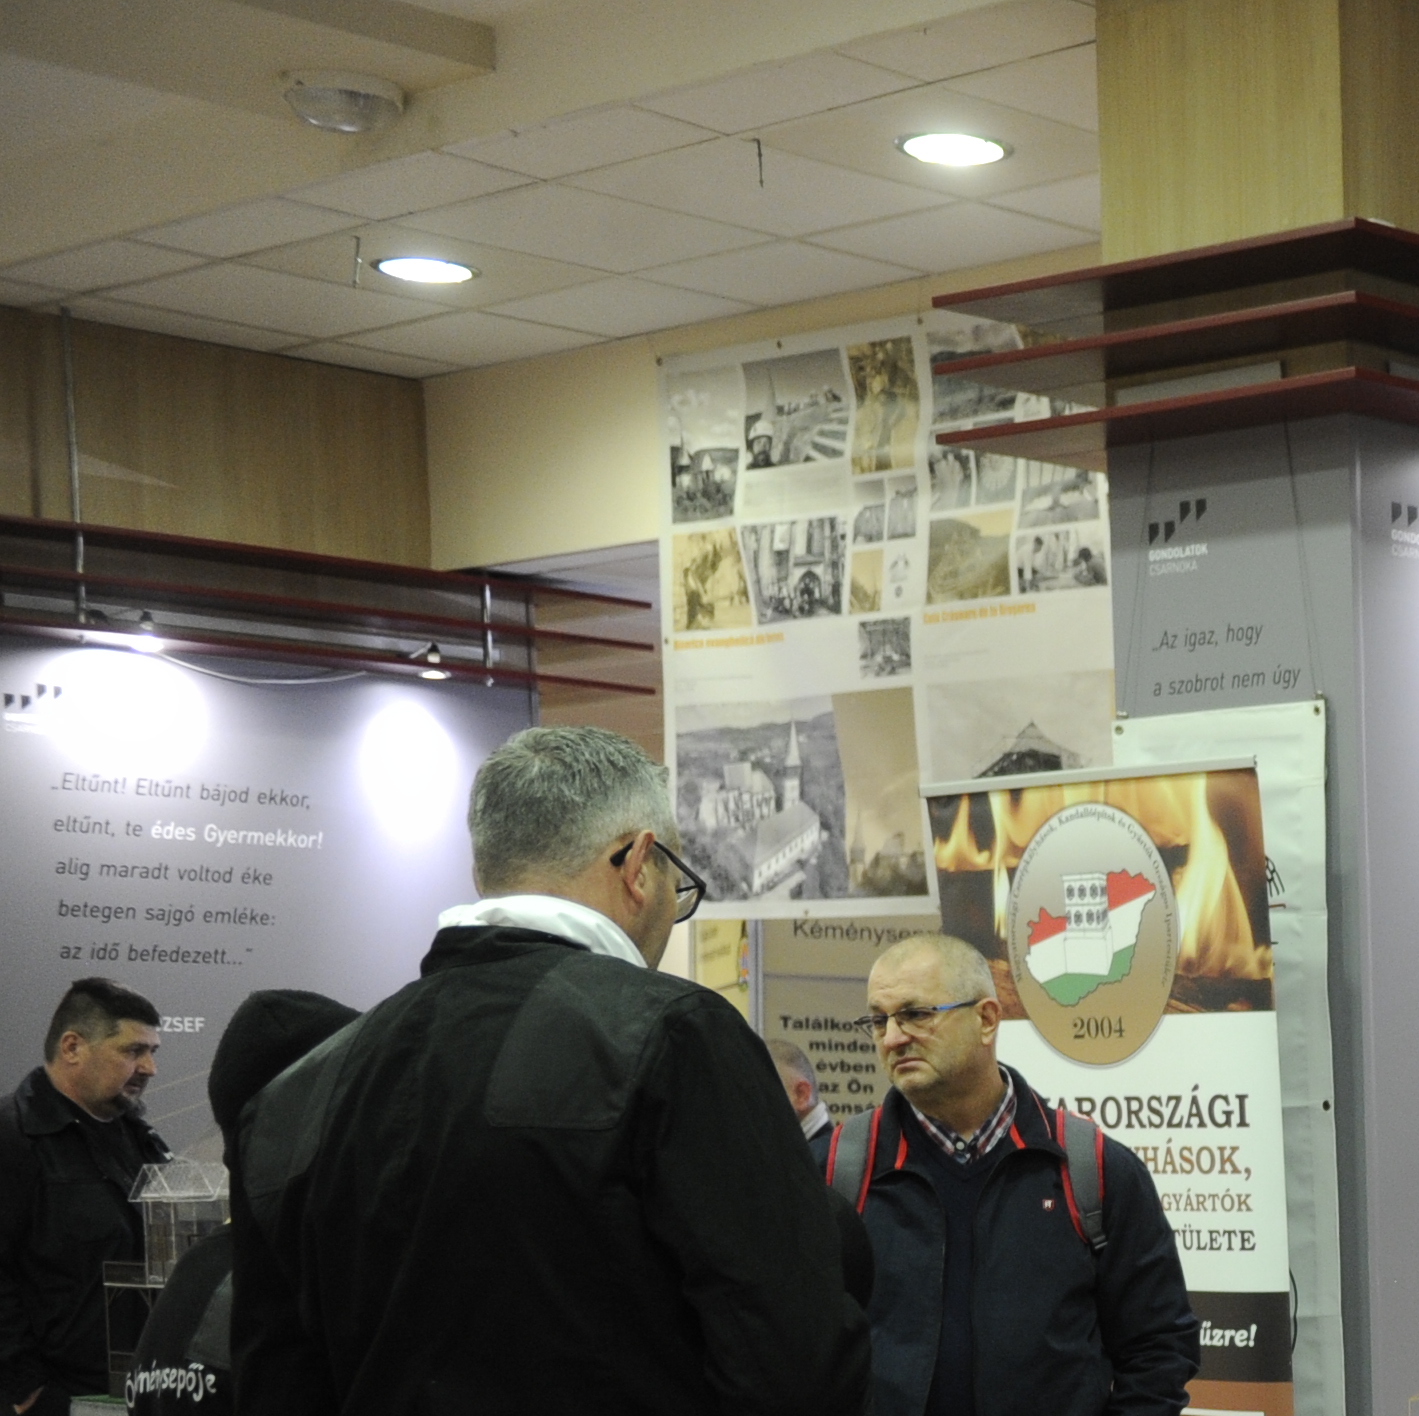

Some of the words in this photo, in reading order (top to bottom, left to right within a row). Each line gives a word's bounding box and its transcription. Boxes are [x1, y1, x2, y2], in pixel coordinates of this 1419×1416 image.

[1184, 628, 1218, 653] igaz,
[1226, 623, 1264, 647] hogy
[1153, 681, 1162, 697] a
[1168, 672, 1225, 696] szobrot
[1231, 672, 1266, 690] nem
[1272, 664, 1301, 690] úgy
[135, 777, 191, 799] Eltűnt
[200, 784, 249, 806] bájod
[257, 789, 311, 810] ekkor,
[53, 815, 116, 838] eltűnt,
[125, 821, 144, 837] te
[150, 821, 197, 841] édes
[203, 823, 323, 849] Gyermekkor!
[55, 858, 90, 880] alig
[100, 861, 169, 880] maradt
[177, 865, 233, 884] voltod
[240, 866, 273, 886] éke
[58, 900, 136, 924] betegen
[144, 904, 196, 927] sajgó
[202, 905, 276, 926] emléke:
[60, 946, 82, 961] az
[90, 941, 119, 962] idő
[156, 1016, 206, 1034] ZSEF
[1072, 1016, 1126, 1040] 2004
[816, 1059, 876, 1074] évben
[847, 1078, 874, 1094] Ön
[1161, 1188, 1253, 1213] GYÁRTÓK
